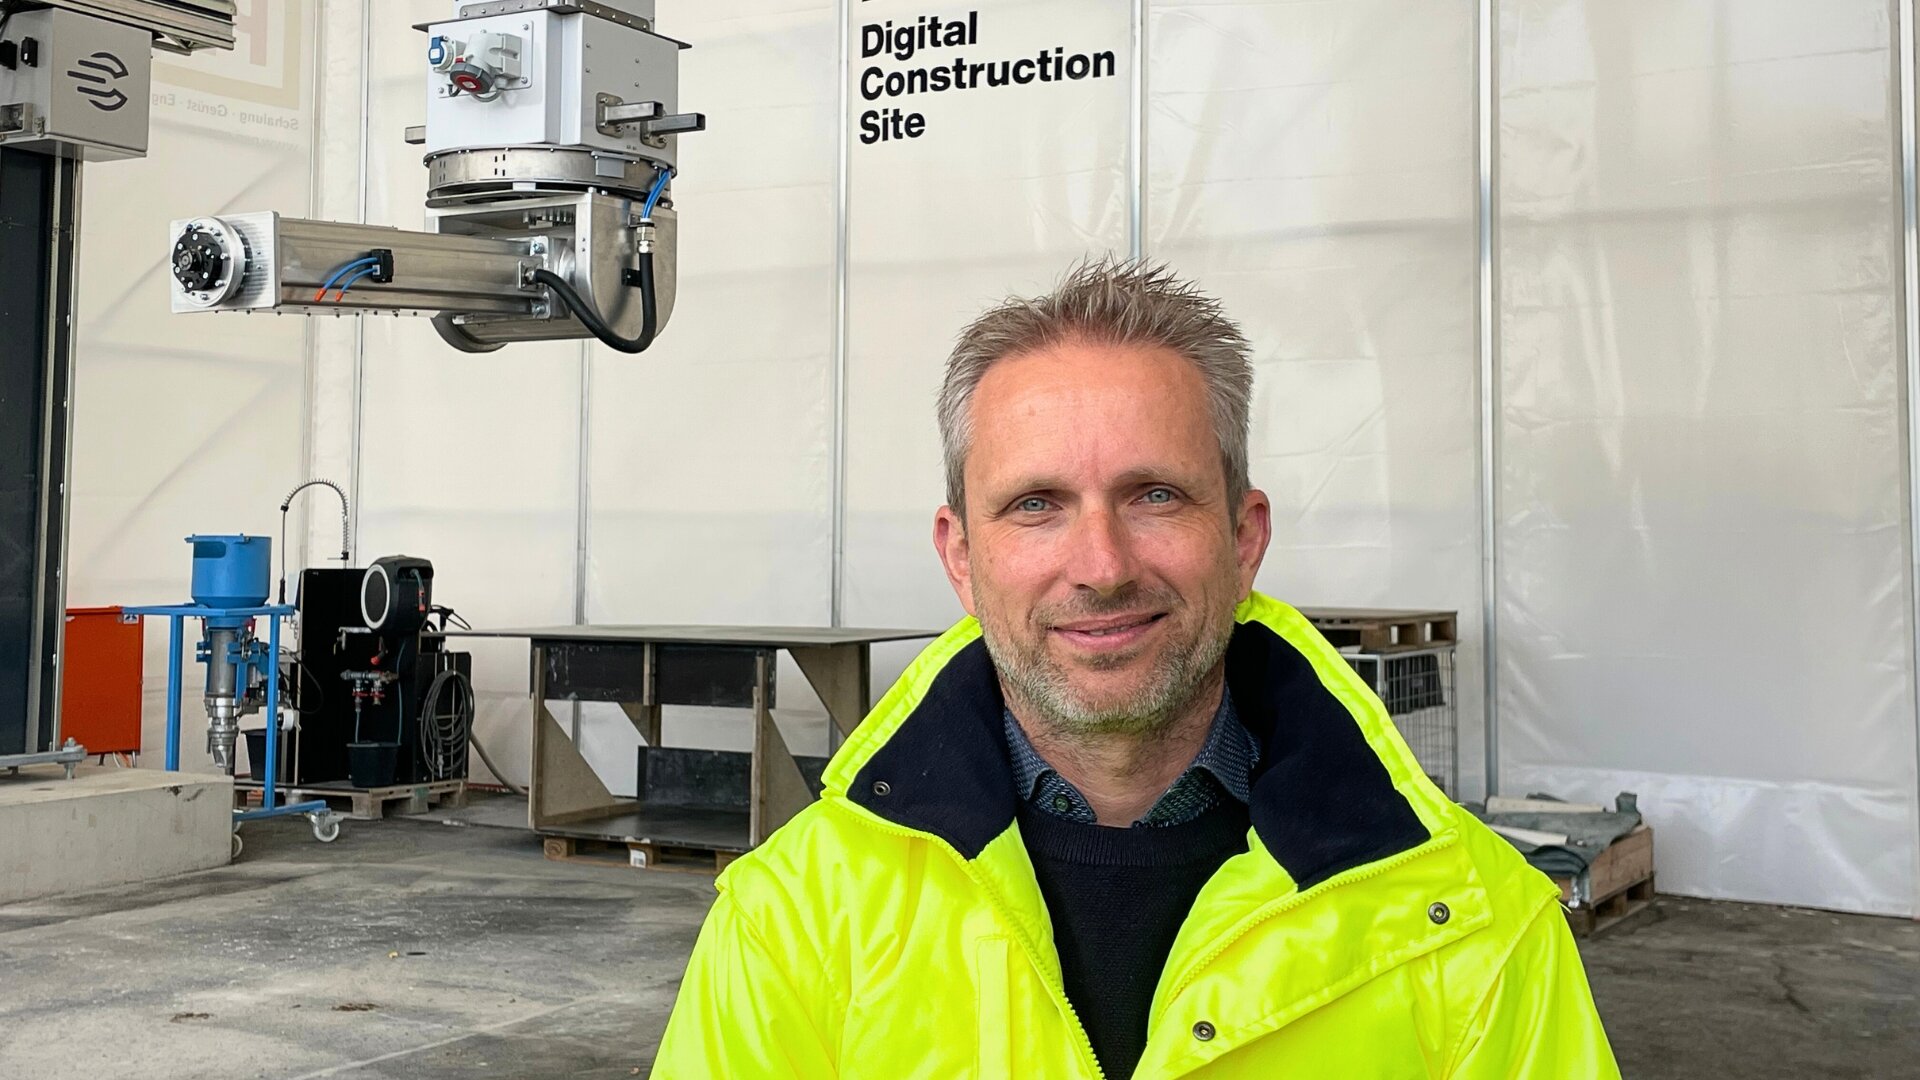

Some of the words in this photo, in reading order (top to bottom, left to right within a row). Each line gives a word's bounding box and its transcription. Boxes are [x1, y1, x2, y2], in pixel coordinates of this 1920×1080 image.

[861, 10, 978, 61] Digital
[860, 46, 1115, 101] Construction
[859, 108, 926, 145] Site
